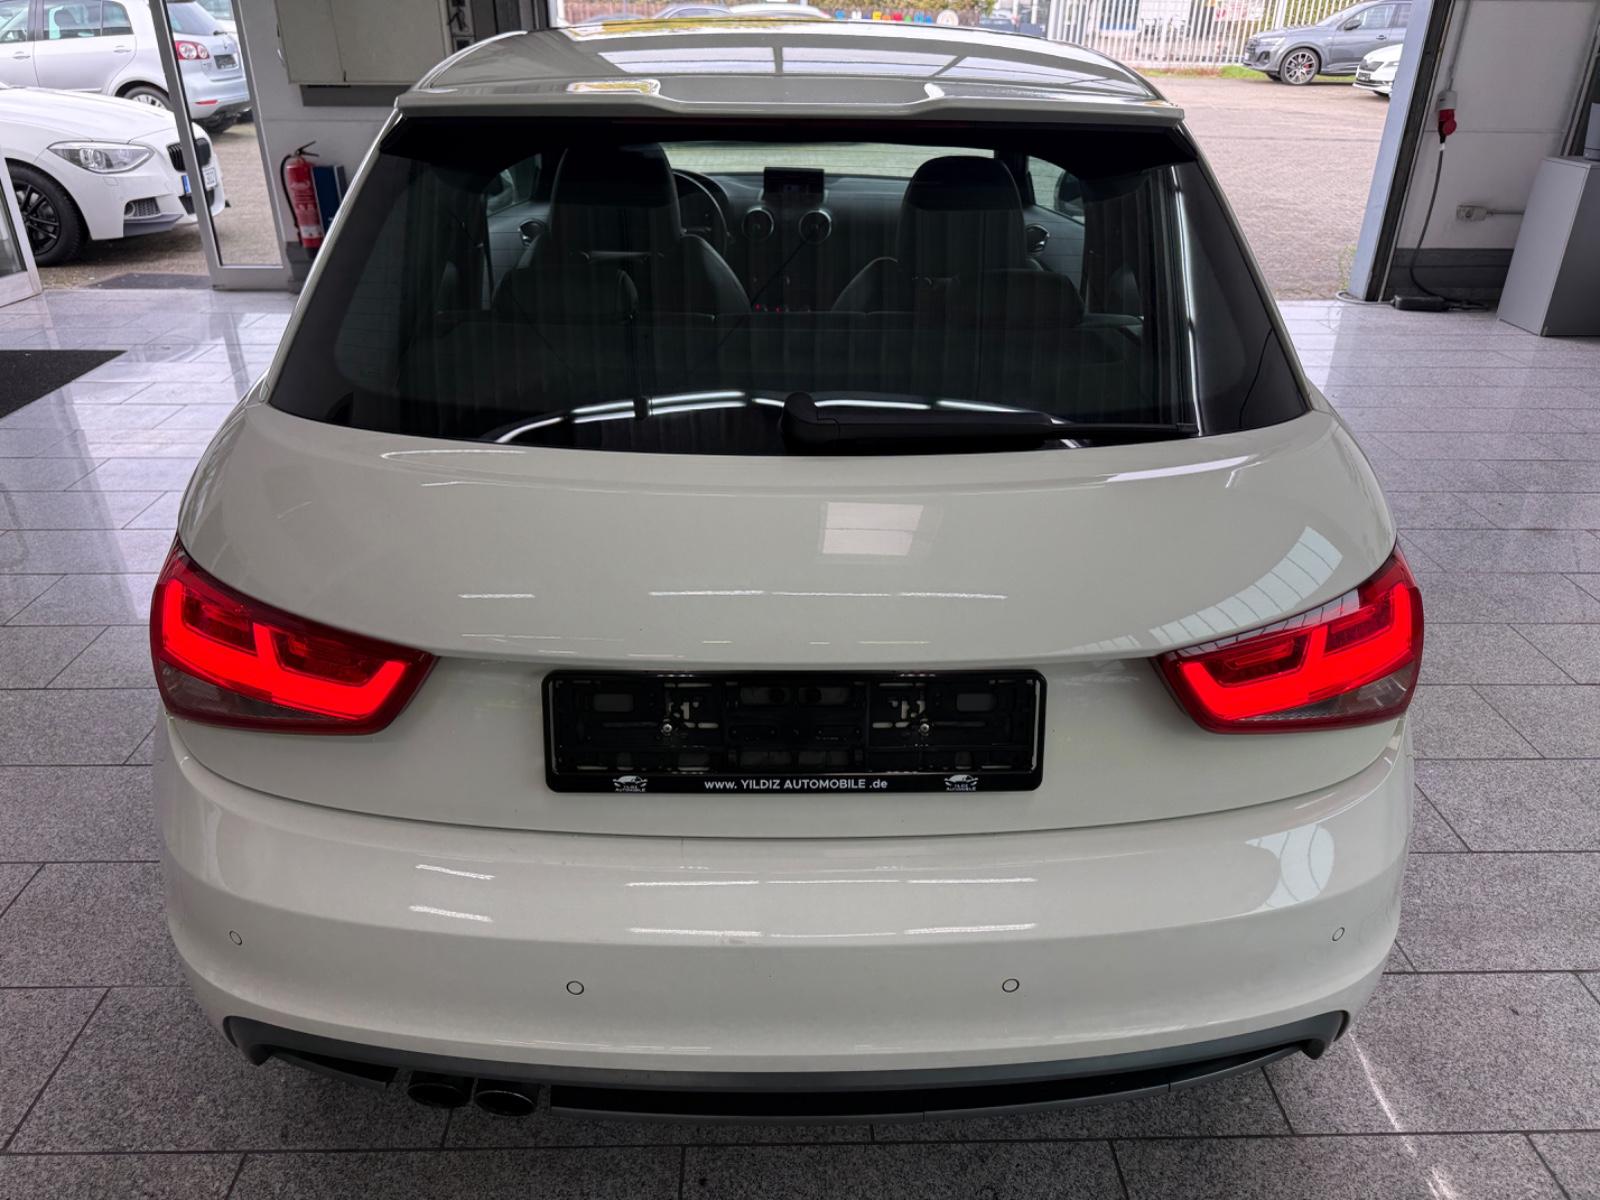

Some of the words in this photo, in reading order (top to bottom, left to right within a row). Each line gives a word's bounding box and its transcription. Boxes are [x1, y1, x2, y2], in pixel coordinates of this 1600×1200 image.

[704, 781, 737, 789] www.
[741, 779, 781, 789] YILDIZ
[783, 779, 866, 789] AUTOMOBILE
[869, 779, 888, 789] .de
